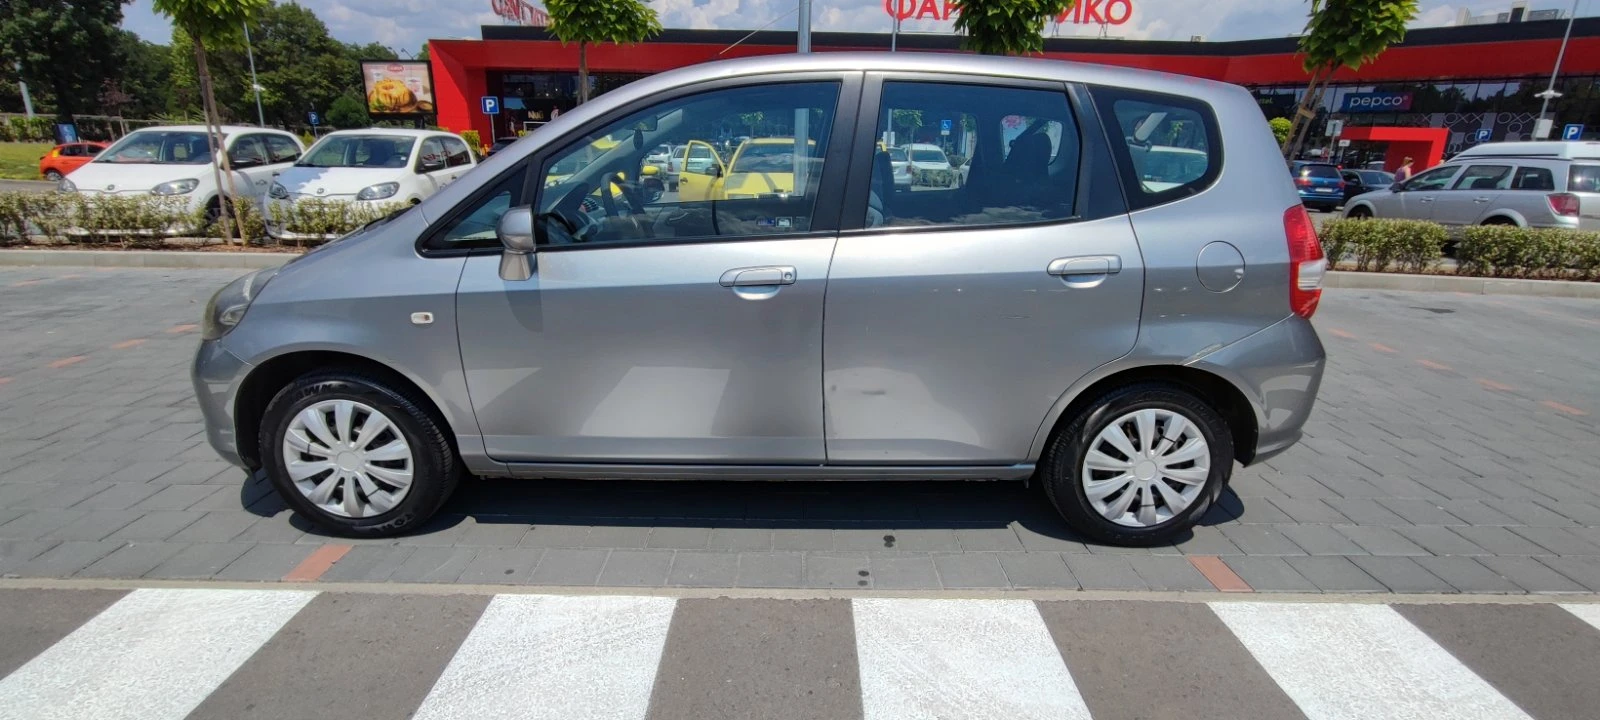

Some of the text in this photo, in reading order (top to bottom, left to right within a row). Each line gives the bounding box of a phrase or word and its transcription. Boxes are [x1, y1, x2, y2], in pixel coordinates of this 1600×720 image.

[486, 99, 495, 112] P
[1349, 96, 1403, 108] pepco
[1478, 131, 1487, 139] P
[1567, 127, 1578, 139] P
